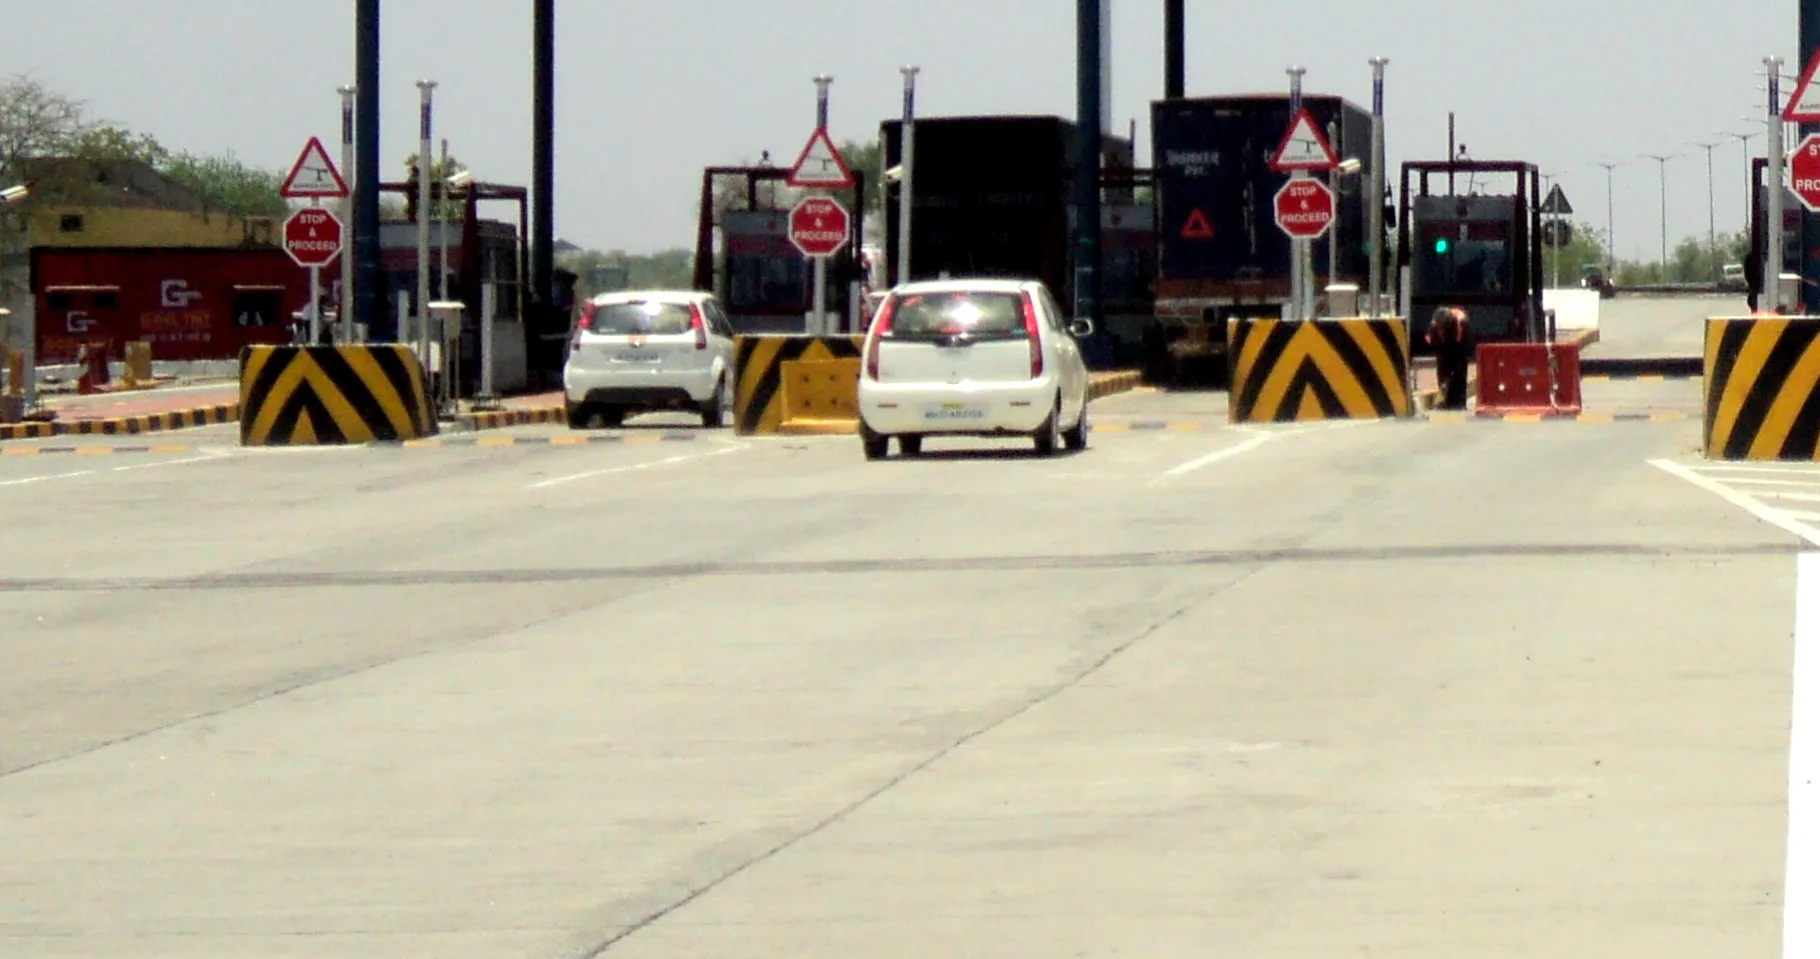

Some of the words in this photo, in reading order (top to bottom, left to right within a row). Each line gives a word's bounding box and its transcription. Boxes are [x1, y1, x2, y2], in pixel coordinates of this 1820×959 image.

[1289, 186, 1317, 197] STOP
[300, 214, 327, 224] STOP
[1281, 212, 1329, 223] PROCEED
[288, 240, 336, 251] PROCEED
